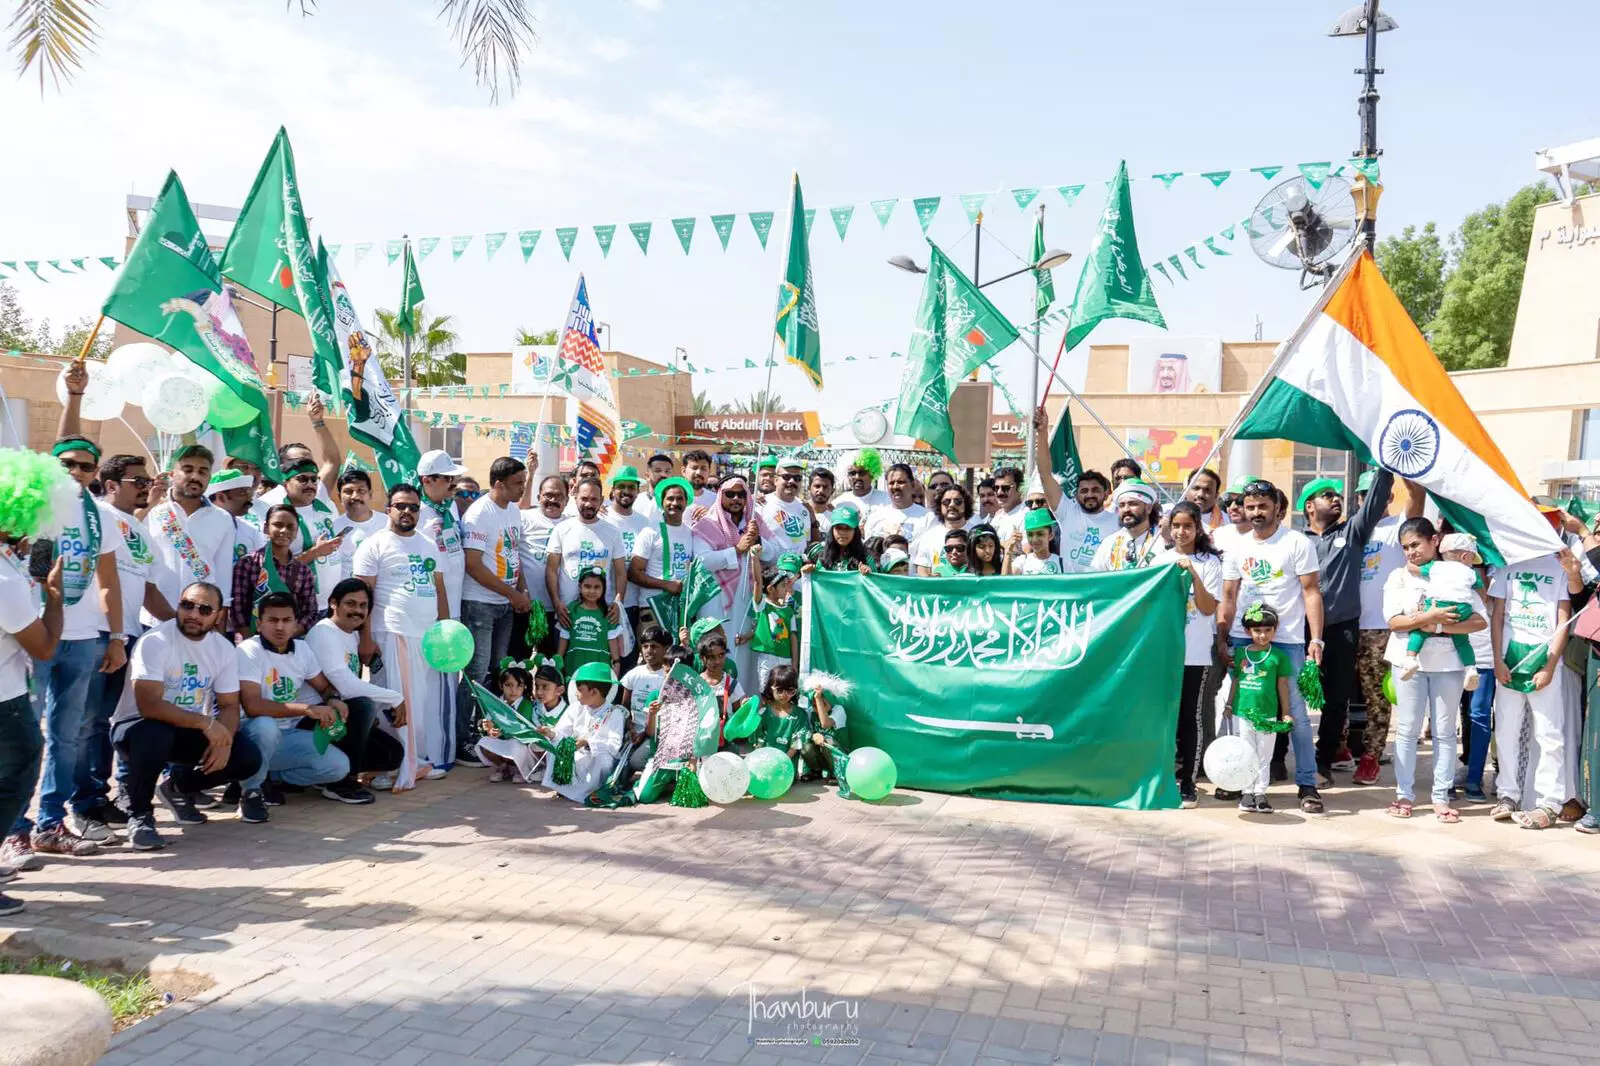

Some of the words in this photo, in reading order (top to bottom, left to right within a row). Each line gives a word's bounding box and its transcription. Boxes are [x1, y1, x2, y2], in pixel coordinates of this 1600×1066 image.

[694, 418, 719, 432] King
[721, 419, 773, 431] Abdullah
[776, 419, 802, 431] Park
